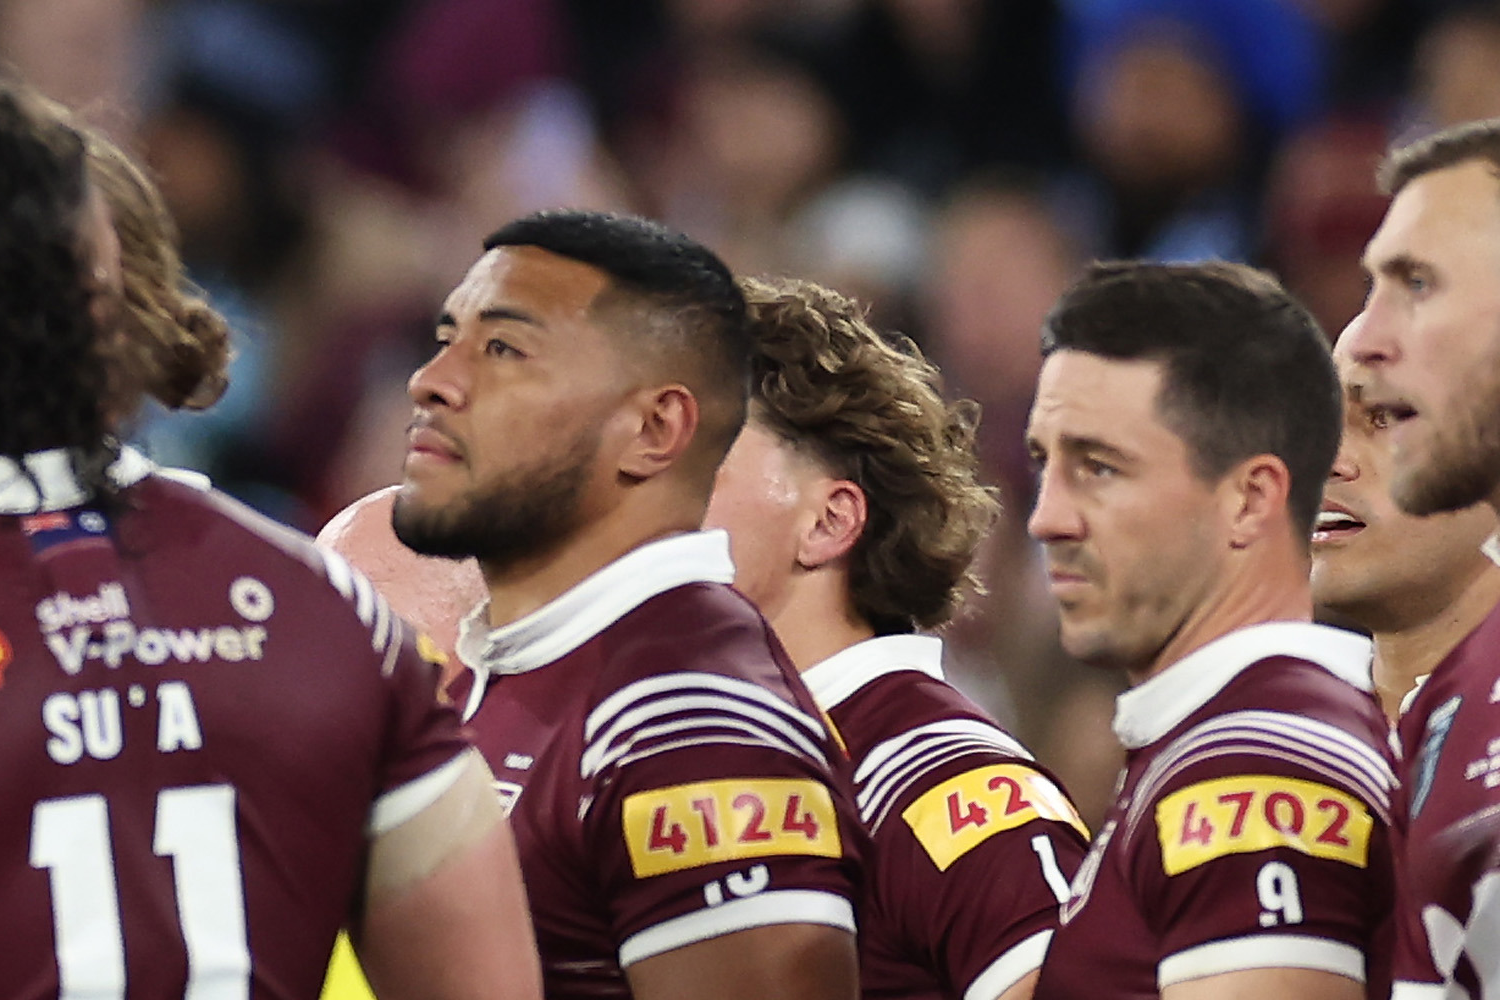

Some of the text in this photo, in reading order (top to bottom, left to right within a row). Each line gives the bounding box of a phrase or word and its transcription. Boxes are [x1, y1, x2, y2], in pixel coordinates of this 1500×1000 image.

[47, 621, 268, 676] V-Power
[42, 680, 203, 766] SU'A
[648, 794, 819, 855] 4124
[1179, 791, 1350, 847] 4702
